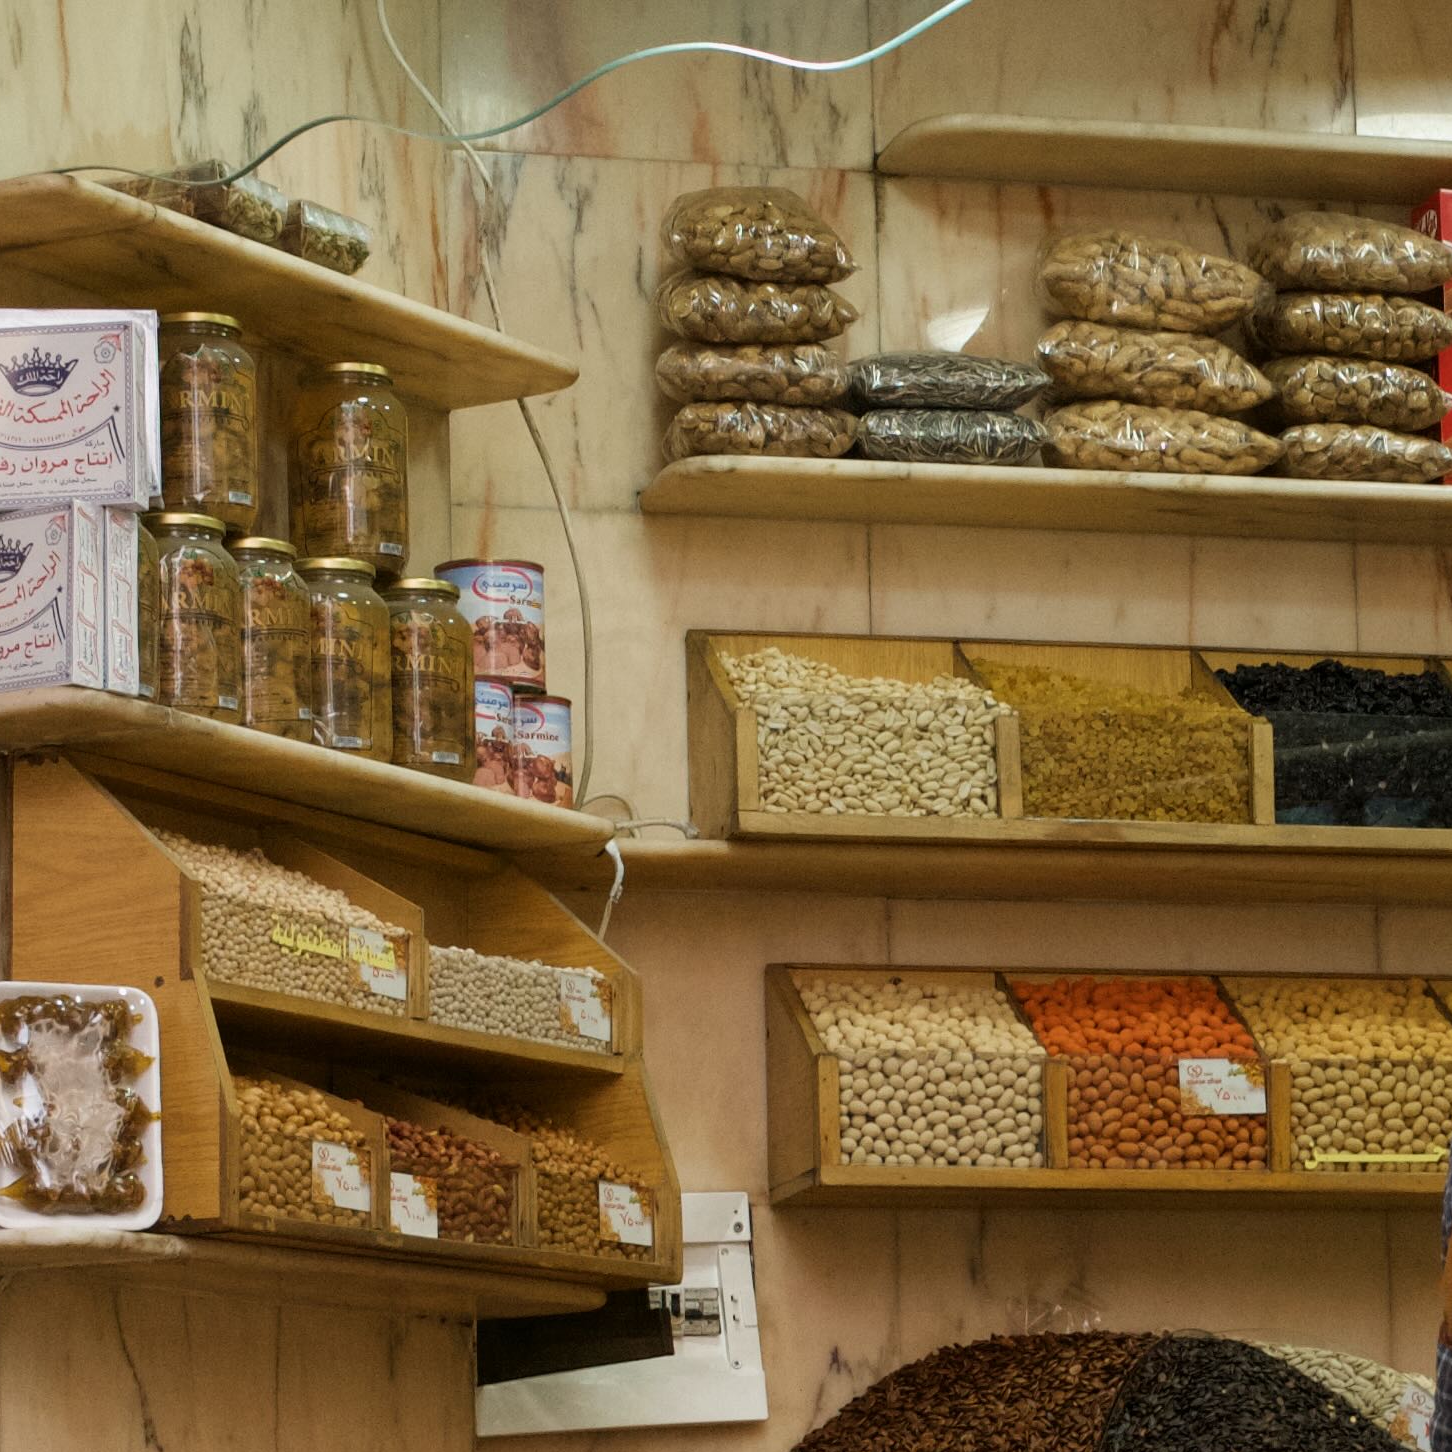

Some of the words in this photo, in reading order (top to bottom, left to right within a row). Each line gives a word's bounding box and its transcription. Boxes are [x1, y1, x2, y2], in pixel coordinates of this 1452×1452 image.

[76, 370, 115, 414] الراحة
[13, 400, 73, 424] الممسكة
[21, 456, 68, 474] مروان
